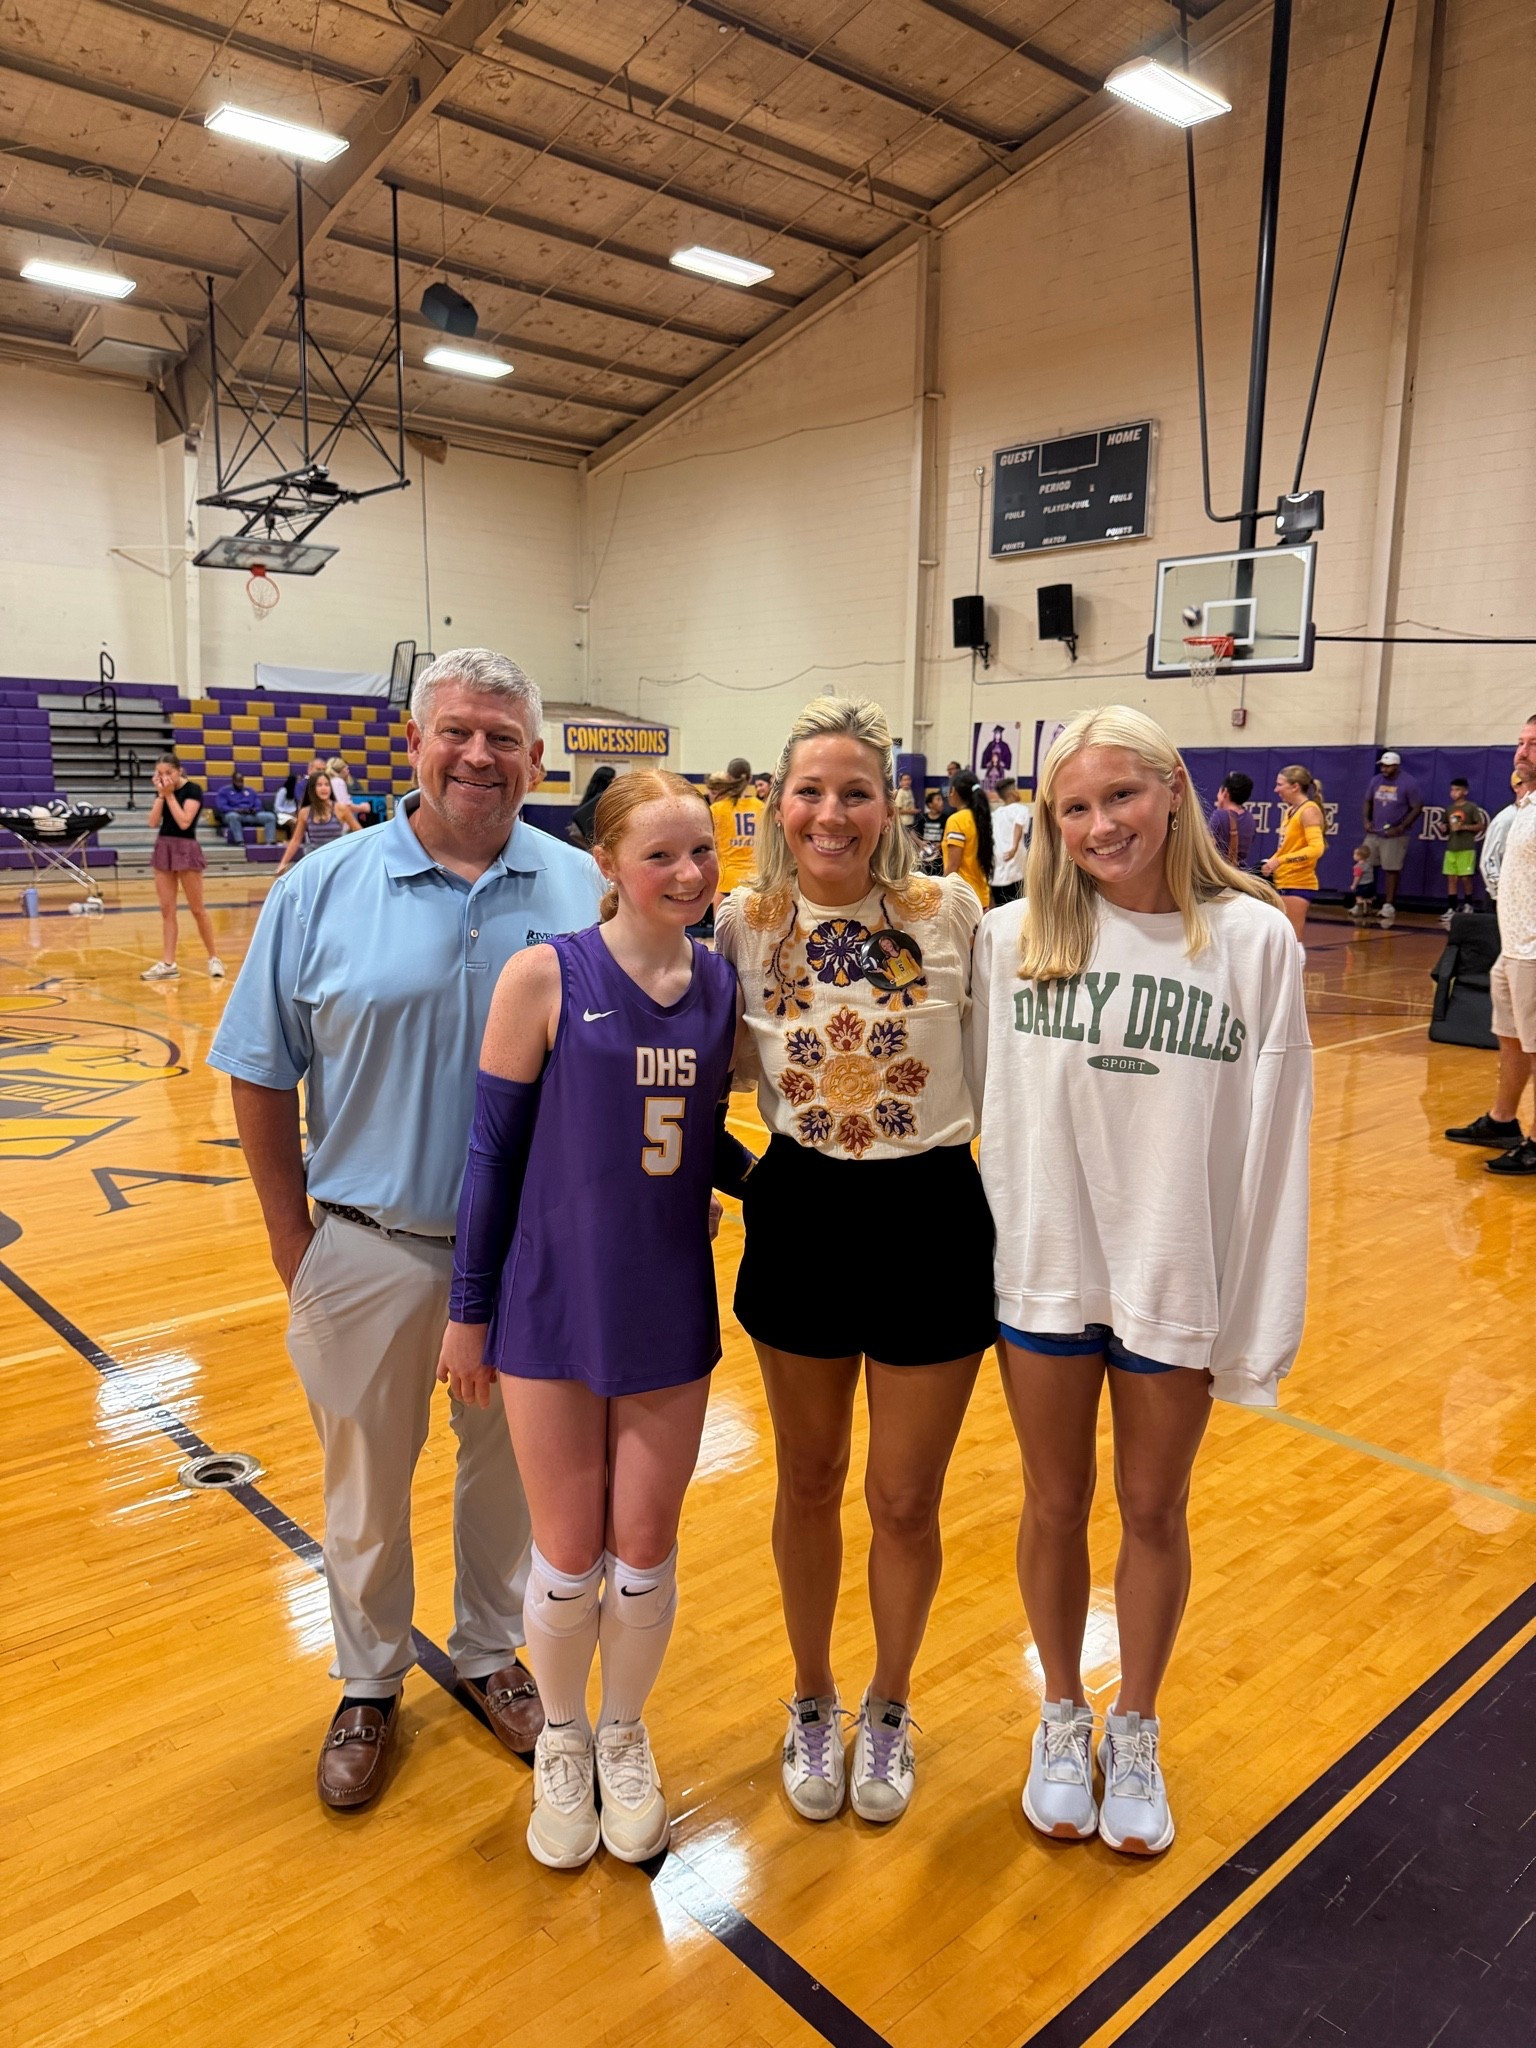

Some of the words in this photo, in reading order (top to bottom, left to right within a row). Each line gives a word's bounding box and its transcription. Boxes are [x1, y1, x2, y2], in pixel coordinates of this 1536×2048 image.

[1107, 429, 1141, 446] HOME
[1000, 451, 1034, 467] GUEST
[1039, 480, 1071, 494] PERIOD
[1109, 493, 1132, 503] FOULS
[1004, 511, 1025, 520] FOULS
[1106, 526, 1132, 536] POINTS
[1002, 541, 1025, 550] POINTS
[1042, 535, 1066, 545] MATCH
[567, 726, 667, 754] CONCESSIONS
[735, 813, 755, 836] 16
[1013, 972, 1121, 1045] DAILY
[636, 1046, 697, 1087] DHS
[1100, 1057, 1146, 1072] SPORT
[641, 1096, 686, 1177] 5
